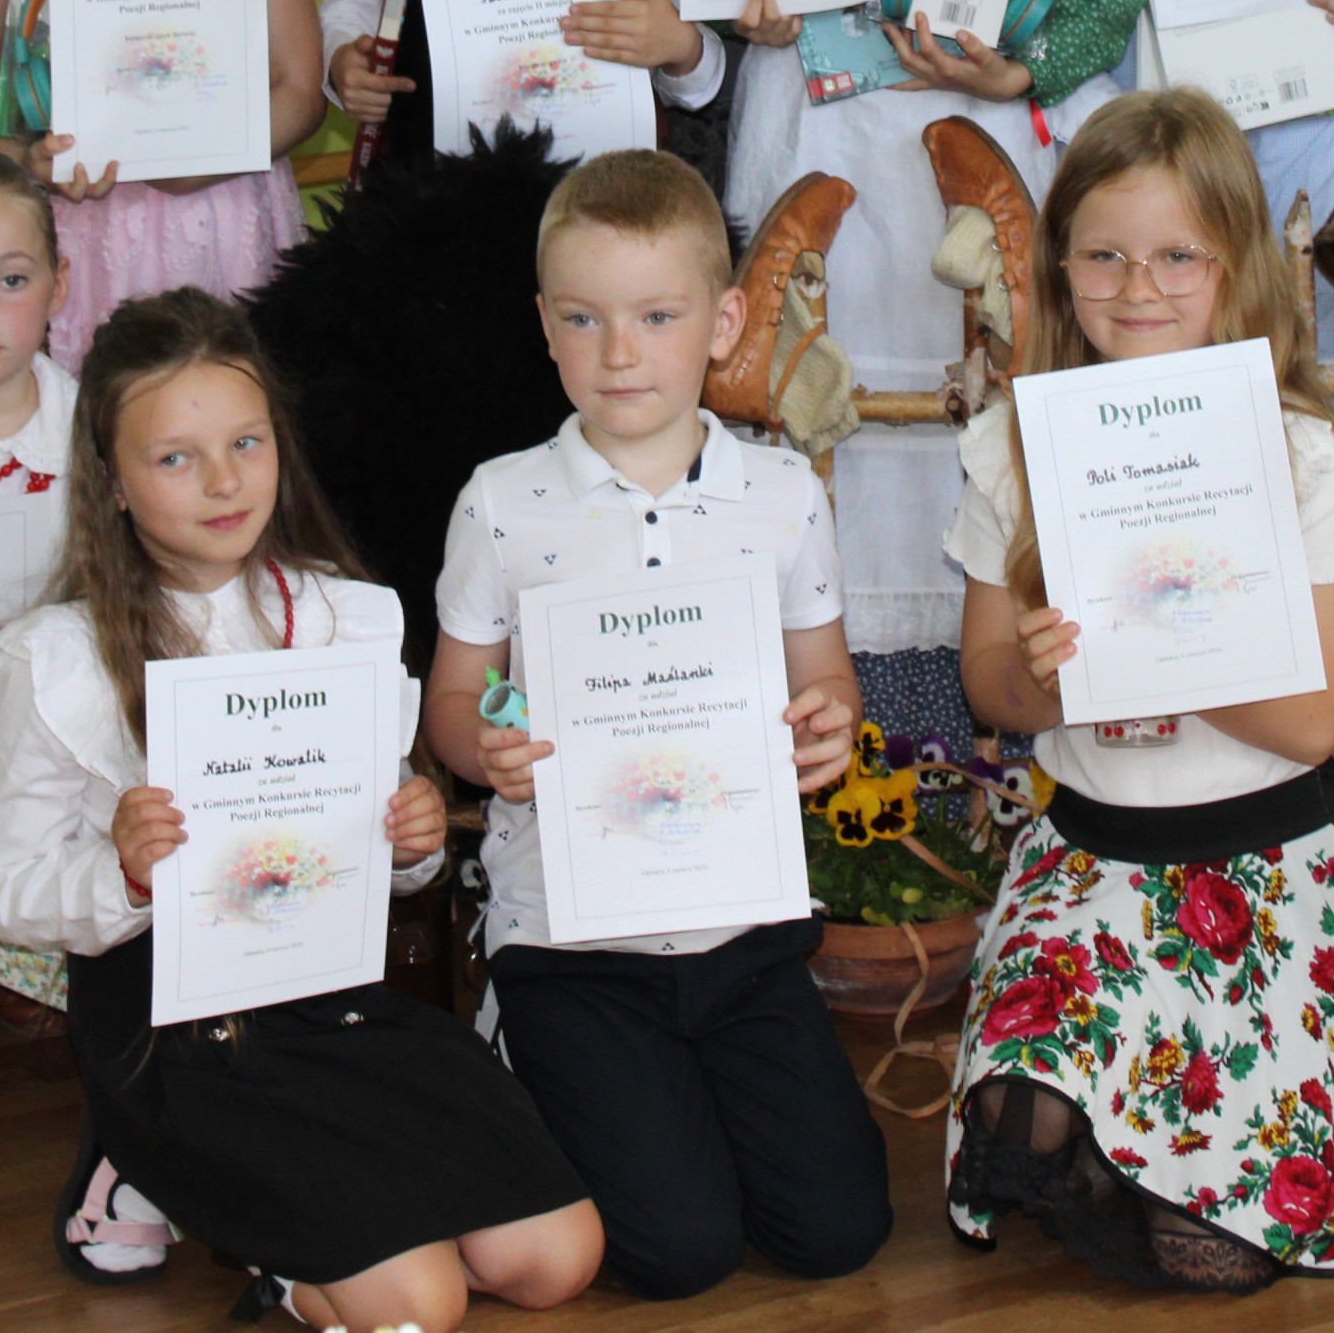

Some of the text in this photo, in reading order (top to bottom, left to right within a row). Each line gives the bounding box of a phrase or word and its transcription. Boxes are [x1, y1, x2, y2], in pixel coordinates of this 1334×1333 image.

[1099, 396, 1203, 428] Dyplom
[1087, 453, 1200, 486] Poli Tomasiak
[1090, 504, 1144, 519] Gminnym
[1146, 494, 1201, 510] Konkursie
[1204, 484, 1253, 500] Recytacji
[1120, 505, 1217, 529] Poezji Regionalnej
[599, 605, 702, 637] Dyplom
[585, 674, 631, 693] Filipa
[226, 689, 326, 720] Dyplom
[583, 713, 637, 726] Gminnym
[640, 705, 695, 719] Konkursie
[698, 699, 747, 713] Recytacji
[612, 718, 710, 738] Poezji Regionalnej
[203, 749, 326, 777] Natalii Kowalik
[192, 783, 361, 811] w Gminnym Konkursie Recytacji
[230, 802, 324, 822] Poezji Regionalnej
